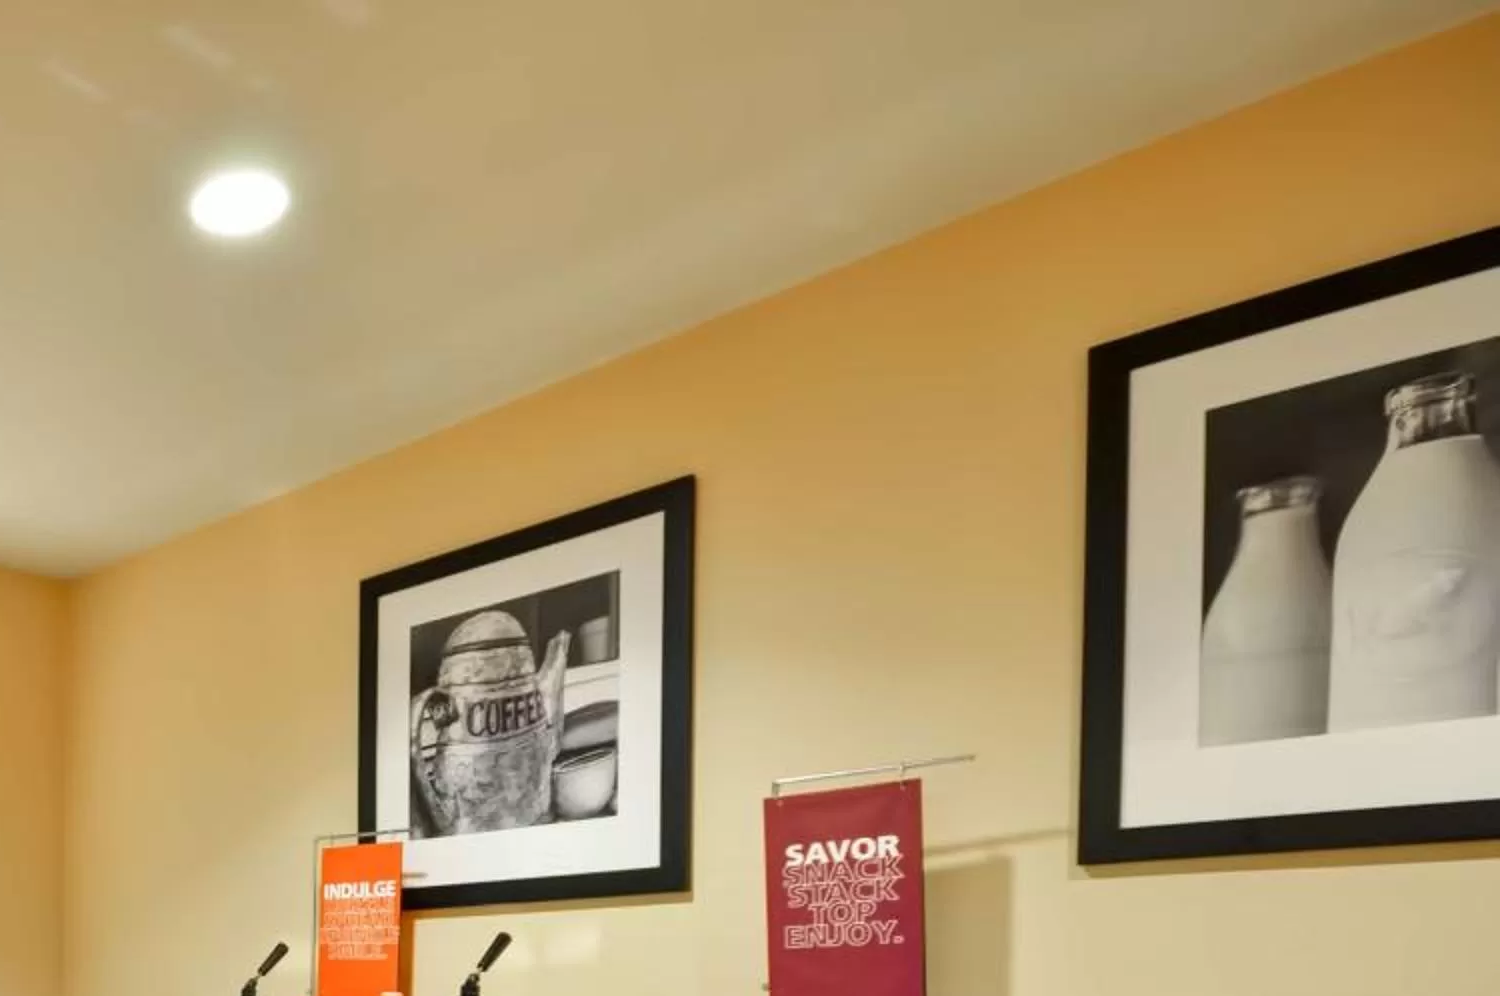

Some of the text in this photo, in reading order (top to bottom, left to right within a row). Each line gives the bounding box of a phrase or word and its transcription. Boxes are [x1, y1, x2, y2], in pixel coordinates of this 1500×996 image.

[466, 688, 545, 737] COFFEE
[784, 835, 900, 866] SAVOR
[782, 855, 905, 888] SNACK
[323, 879, 397, 900] INDULGE
[787, 877, 901, 909] STACK
[807, 899, 877, 926] TOP
[783, 919, 905, 949] ENJOY.
